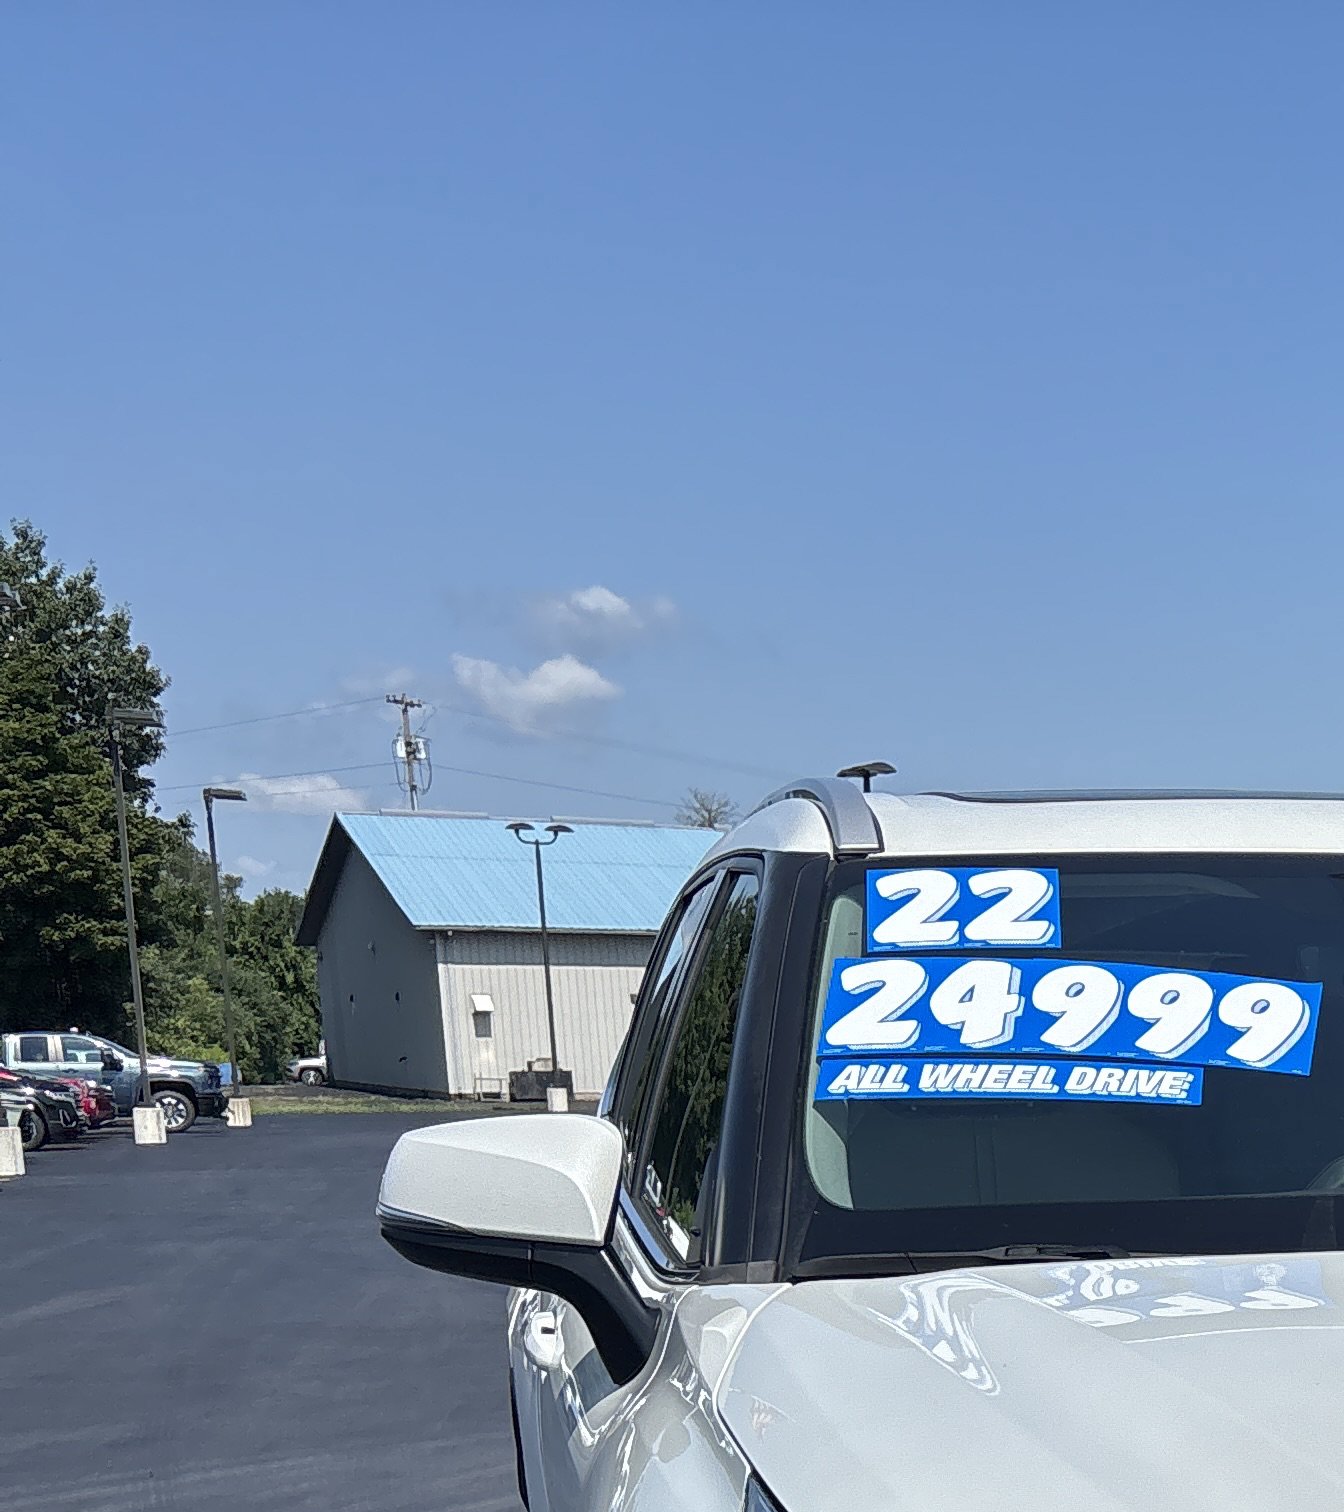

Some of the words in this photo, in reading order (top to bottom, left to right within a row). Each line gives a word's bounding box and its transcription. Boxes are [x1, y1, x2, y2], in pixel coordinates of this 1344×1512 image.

[872, 869, 1054, 948] 22
[825, 959, 1310, 1068] 24999
[827, 1063, 911, 1094] ALL
[918, 1063, 1060, 1095] WHEEL
[1064, 1067, 1195, 1099] DRIVE
